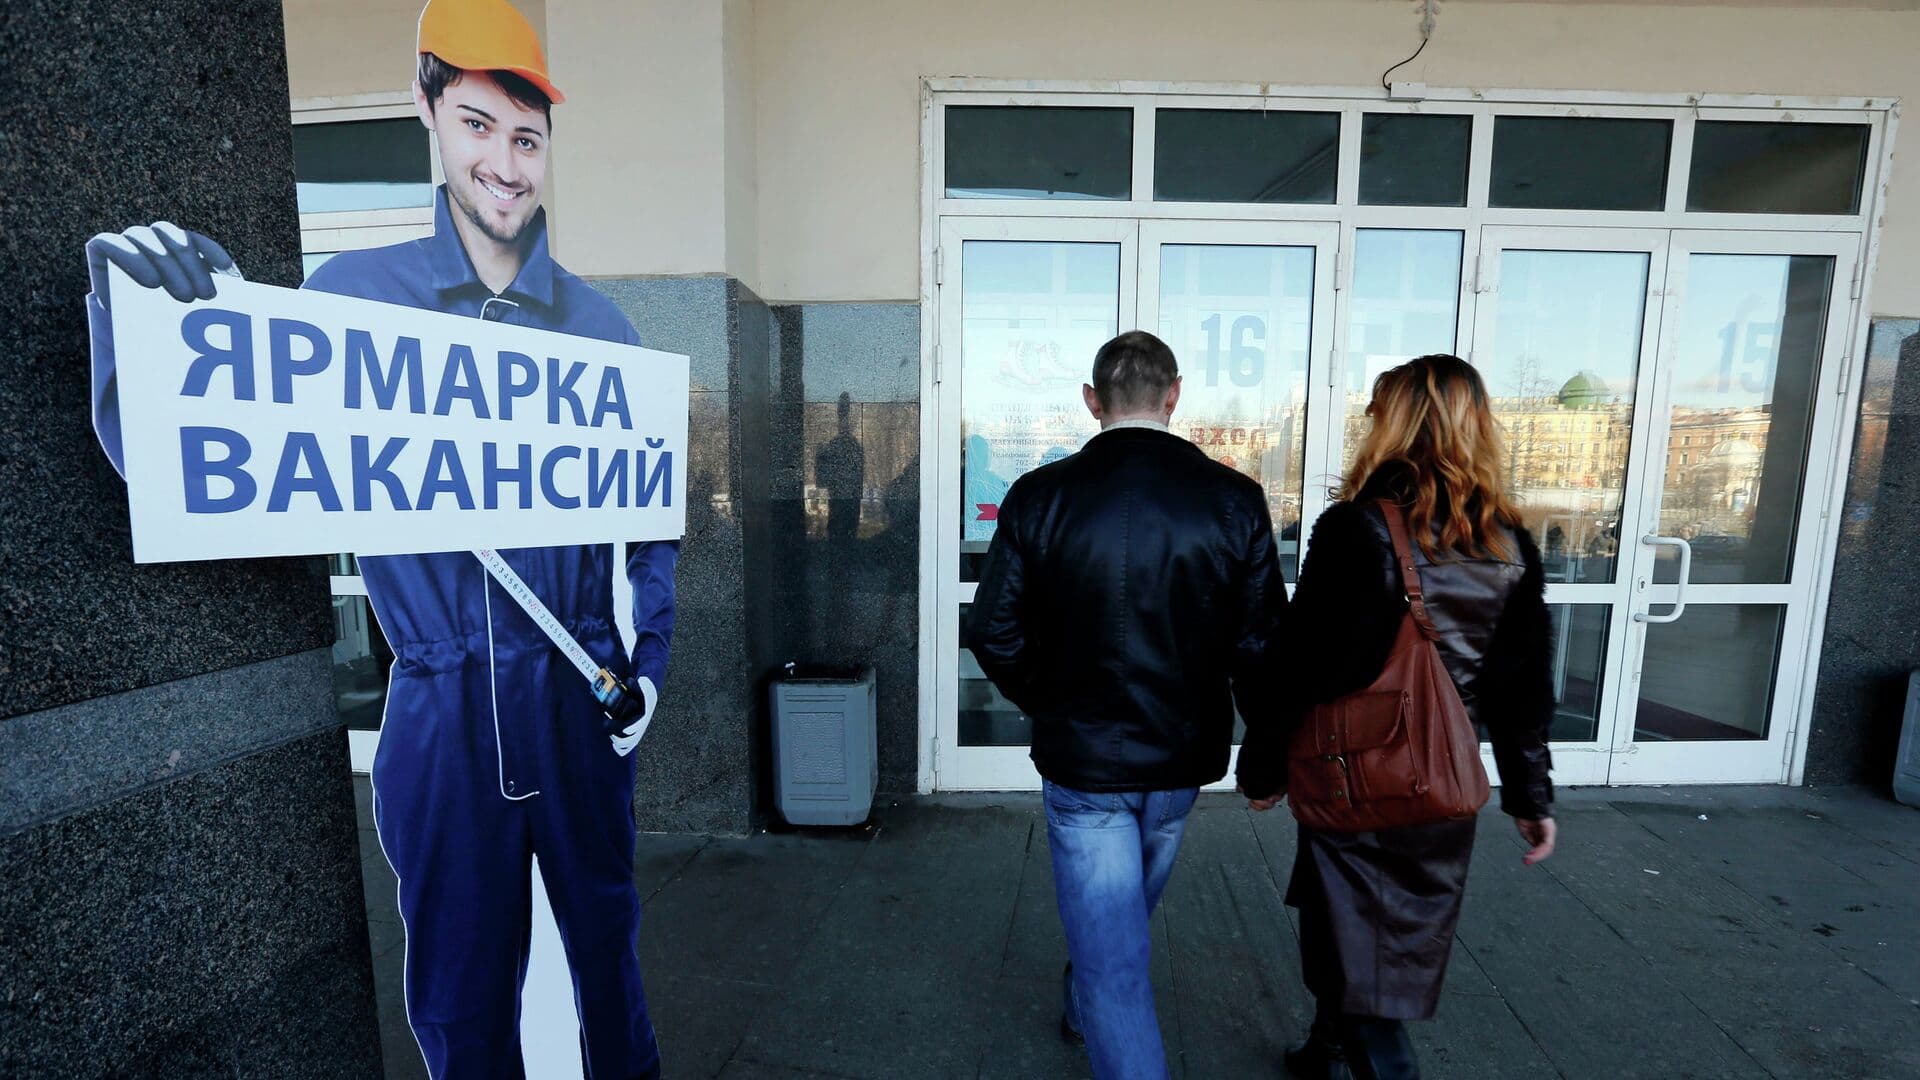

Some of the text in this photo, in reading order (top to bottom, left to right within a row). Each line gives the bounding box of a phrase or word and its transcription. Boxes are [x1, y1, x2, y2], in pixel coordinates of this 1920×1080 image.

[180, 308, 632, 429] ЯРМАРКА
[1201, 313, 1266, 387] 16
[1716, 321, 1781, 394] 15
[179, 426, 672, 514] ВАКАНСИЙ
